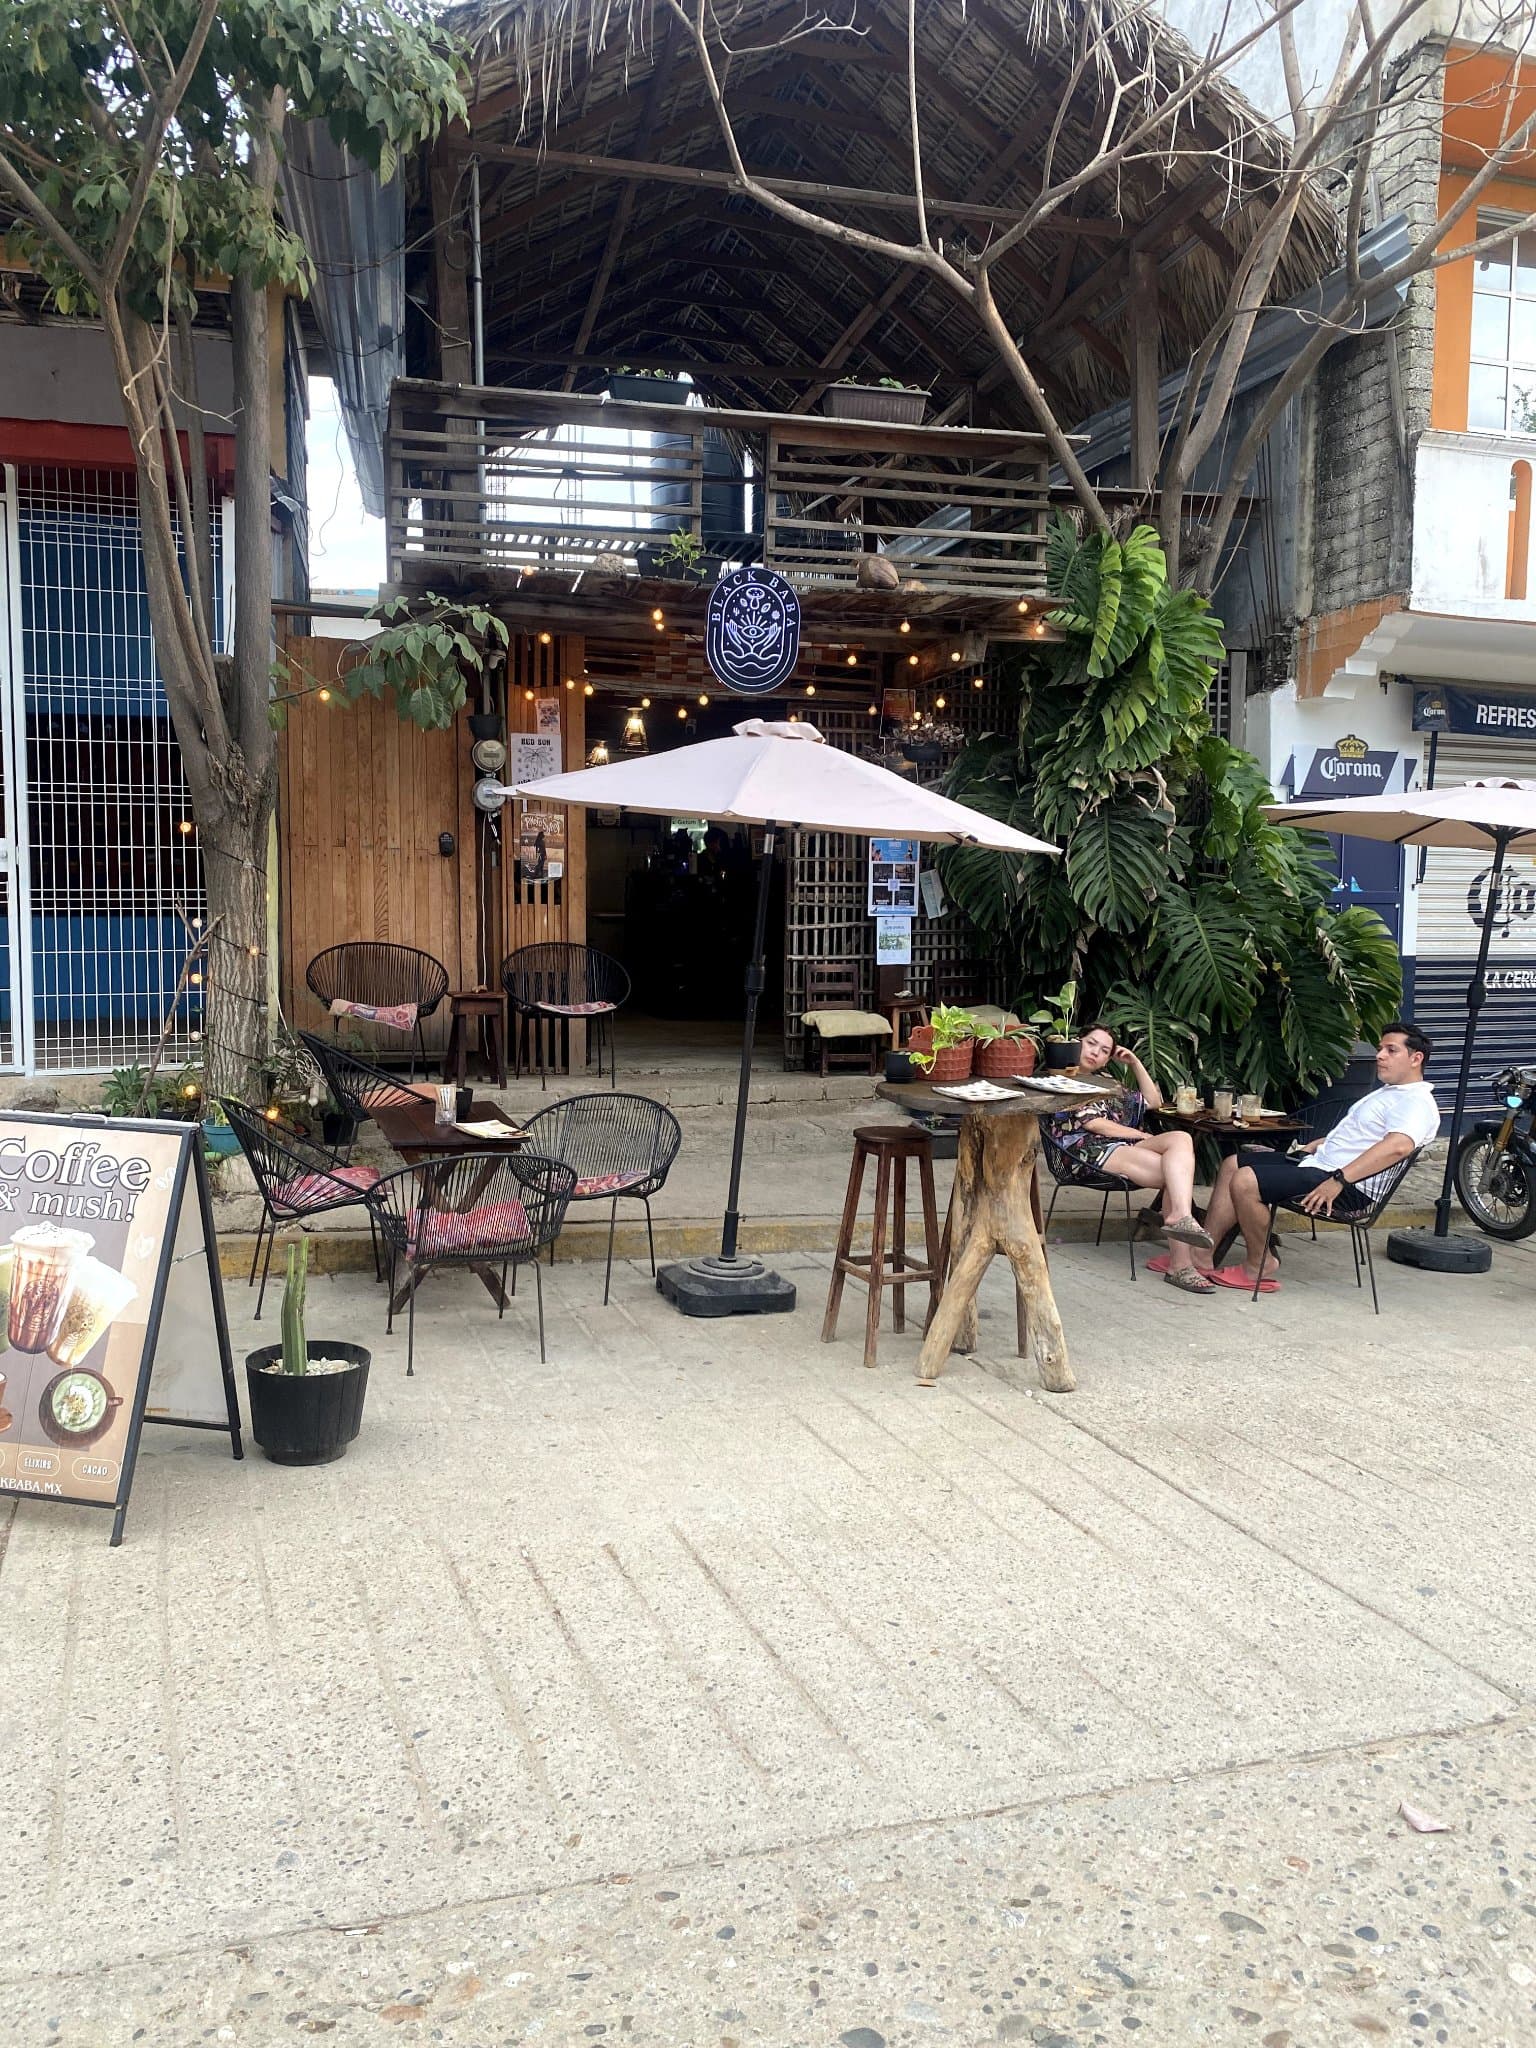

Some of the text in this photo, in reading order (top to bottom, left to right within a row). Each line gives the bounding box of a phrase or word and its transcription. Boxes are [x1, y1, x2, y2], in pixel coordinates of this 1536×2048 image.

[711, 570, 797, 628] BLACK BABA
[1320, 756, 1384, 783] Corona
[1484, 971, 1501, 988] LA
[0, 1136, 152, 1192] Coffee
[28, 1191, 138, 1222] mush!
[82, 1464, 108, 1476] CACAO
